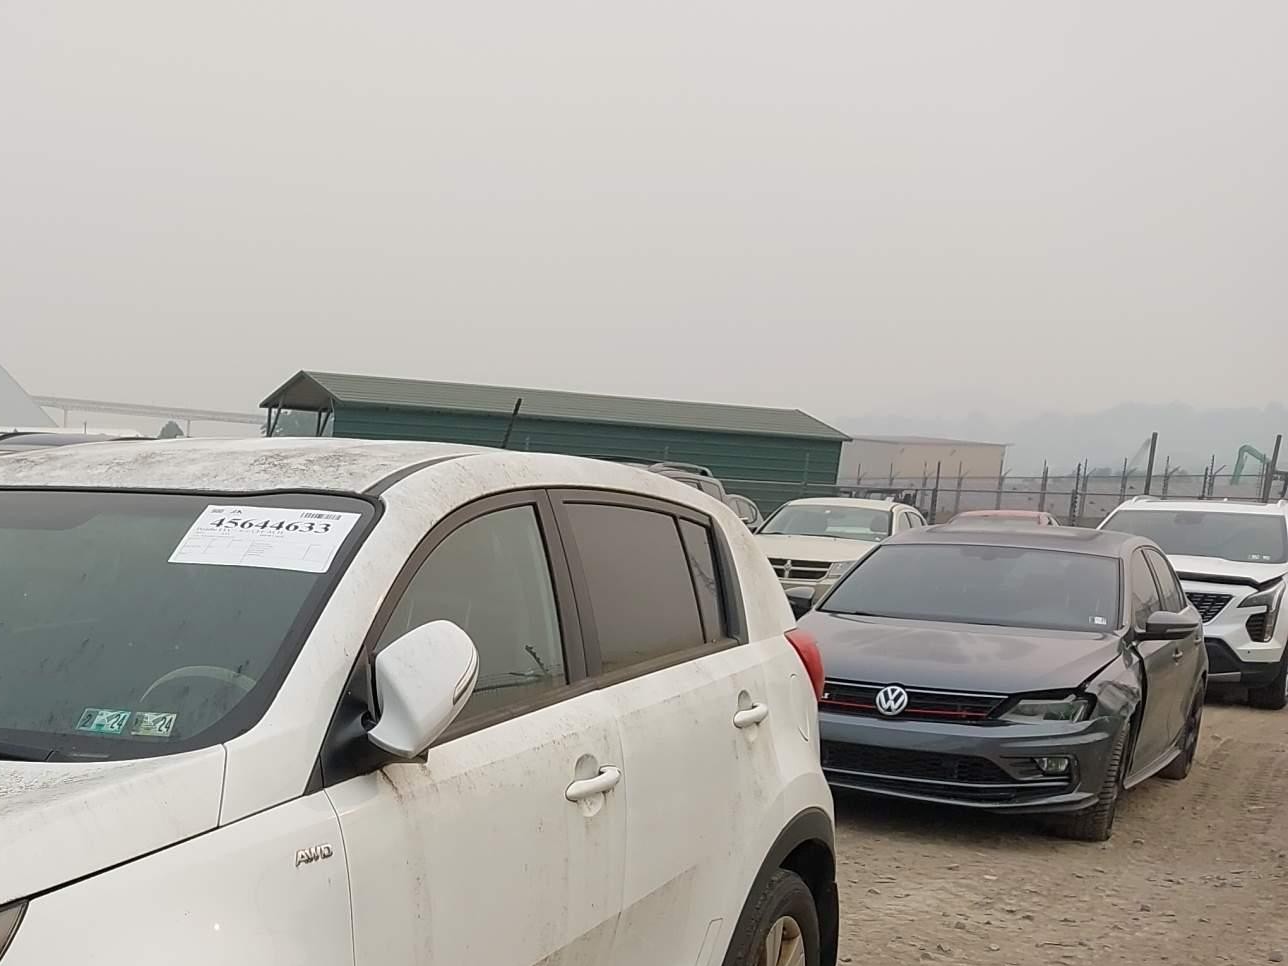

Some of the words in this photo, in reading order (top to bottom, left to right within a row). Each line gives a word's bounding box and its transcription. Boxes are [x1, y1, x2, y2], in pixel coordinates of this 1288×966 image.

[209, 517, 331, 534] 45644633
[876, 686, 908, 715] VW
[110, 714, 128, 730] 24
[157, 716, 174, 732] 24
[295, 844, 333, 867] AWD
